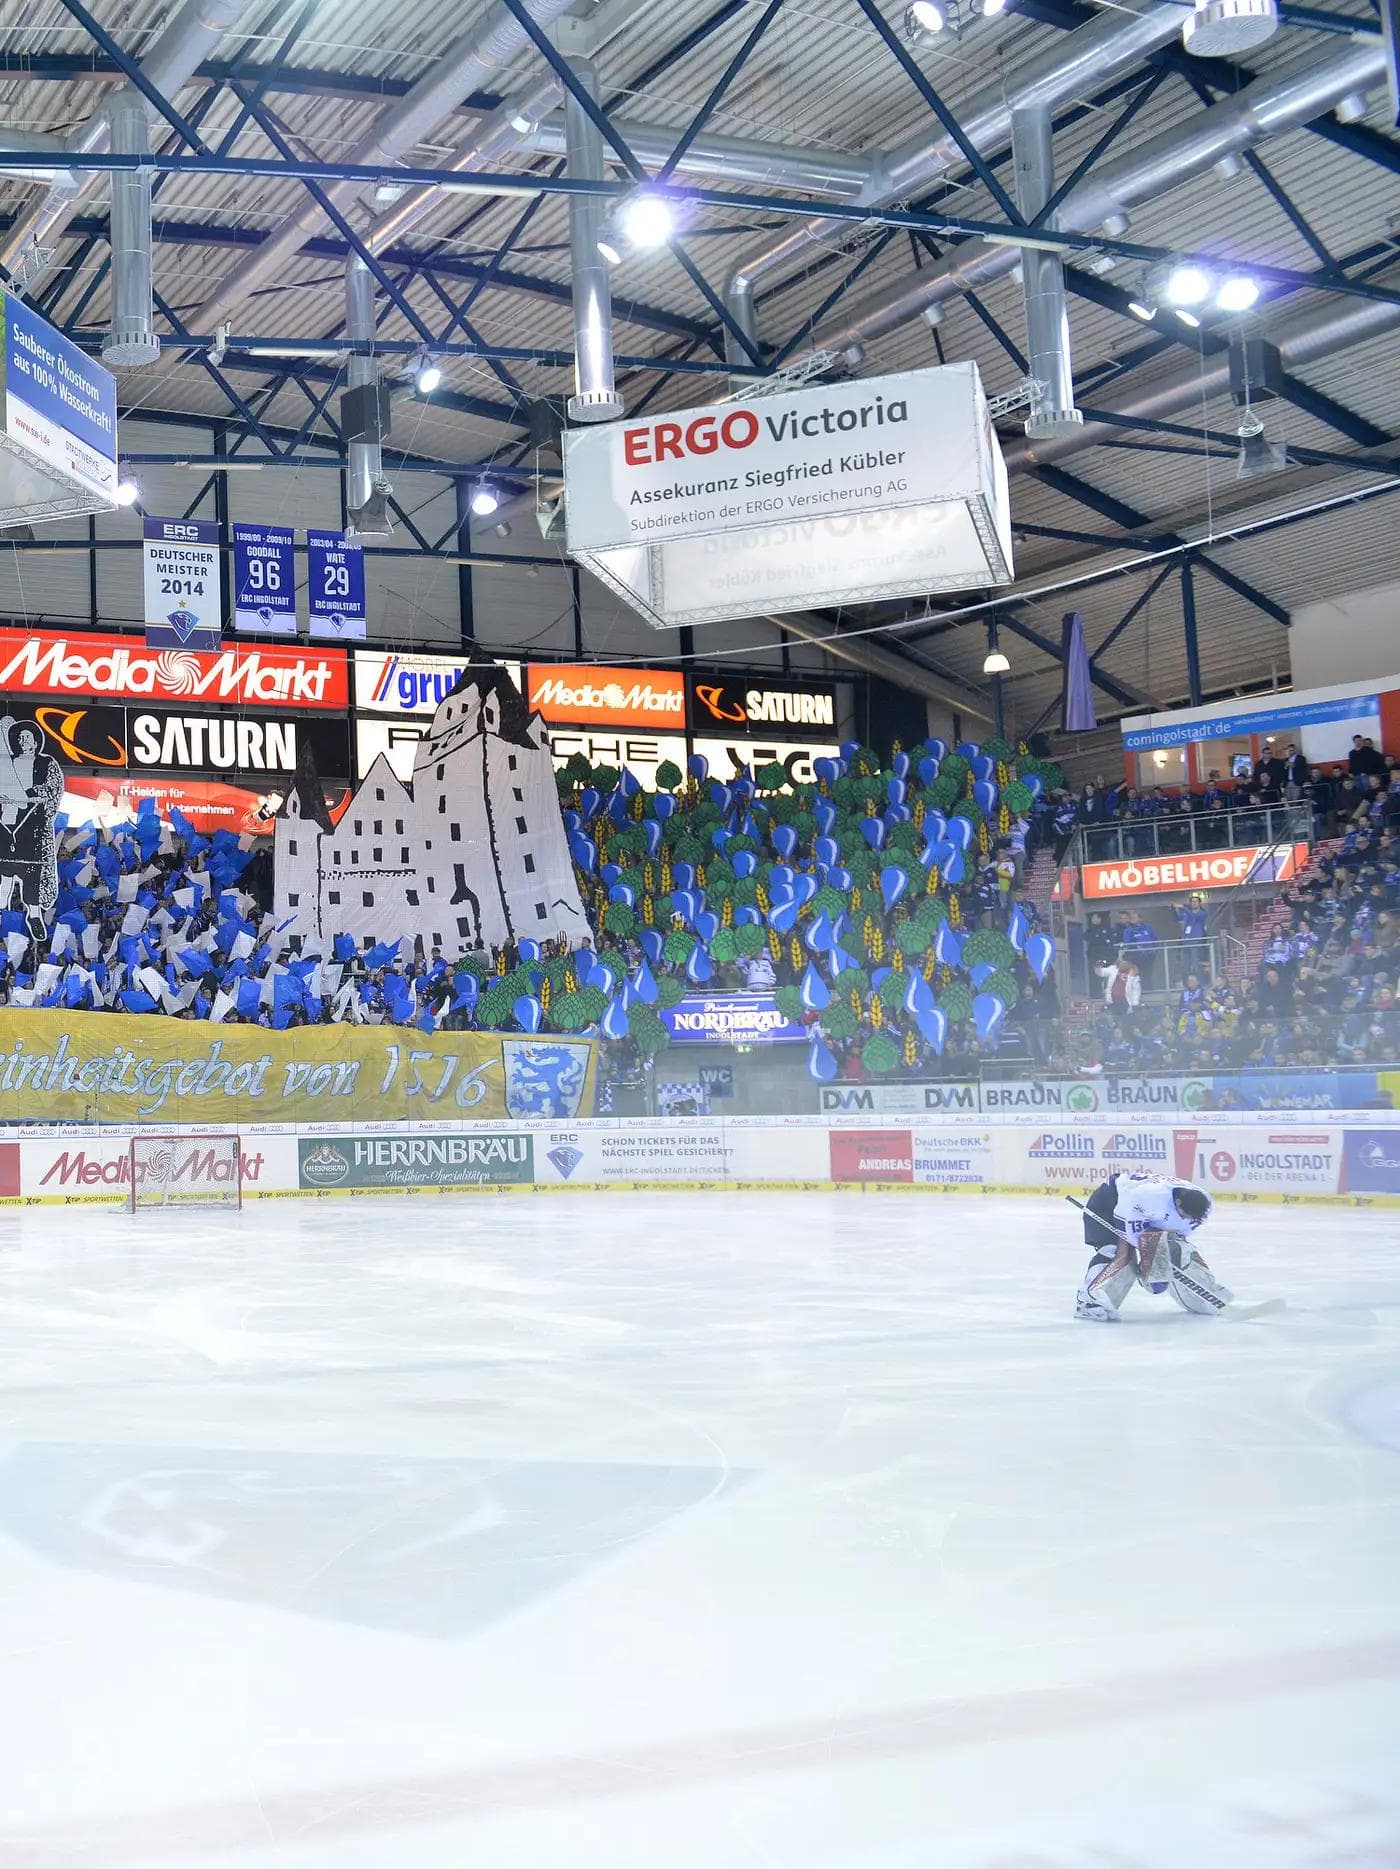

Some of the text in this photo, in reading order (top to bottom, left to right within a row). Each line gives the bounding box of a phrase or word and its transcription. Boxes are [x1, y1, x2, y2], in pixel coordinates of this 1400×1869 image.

[13, 323, 99, 401] Sauberer Ökostrom
[13, 352, 112, 433] aus 100% Wasserkraft!
[15, 416, 51, 447] www.sw-i.de
[624, 396, 908, 466] ERGO Victoria
[65, 440, 101, 470] STADTWERKE
[630, 448, 906, 505] Assekuranz Siegfried Kübler
[630, 478, 907, 531] Subdirektion der ERGO Versicherung AG
[163, 523, 199, 537] ERC
[150, 548, 214, 563] DEUTSCHER
[246, 546, 282, 559] GOODALL
[156, 563, 209, 577] MEISTER
[249, 559, 281, 591] 96
[160, 578, 204, 596] 2014
[324, 565, 349, 596] 29
[241, 593, 290, 606] ERC INGOLSTADT
[315, 599, 361, 612] ERC INGOLSTADT
[192, 649, 333, 701] Markt
[746, 690, 834, 724] SATURN
[133, 714, 297, 771] SATURN
[119, 785, 185, 798] IT-Helden für
[1098, 857, 1250, 889] MÖBELHOF
[706, 1032, 760, 1040] INGOLSTADT
[282, 1057, 362, 1099] von
[379, 1044, 499, 1109] 1516
[701, 1070, 731, 1083] WC
[986, 1088, 1062, 1107] BRAUN
[1106, 1085, 1177, 1105] BRAUN
[19, 1128, 38, 1136] Audi
[141, 1126, 159, 1134] Audi
[308, 1124, 325, 1132] Audi
[473, 1121, 490, 1129] Audi
[550, 1134, 579, 1143] ERC
[601, 1134, 719, 1147] SCHON TICKETS FÜR DAS
[1042, 1133, 1095, 1150] Pollin
[1114, 1133, 1167, 1151] Pollin
[354, 1137, 528, 1168] HERRNBRÄU
[602, 1147, 734, 1158] NÄCHSTE SPIEL GESICHERT?
[858, 1158, 971, 1171] ANDREAS BRUMMET
[1239, 1154, 1332, 1170] INGOLSTADT
[83, 1195, 123, 1203] SPORTWETTEN
